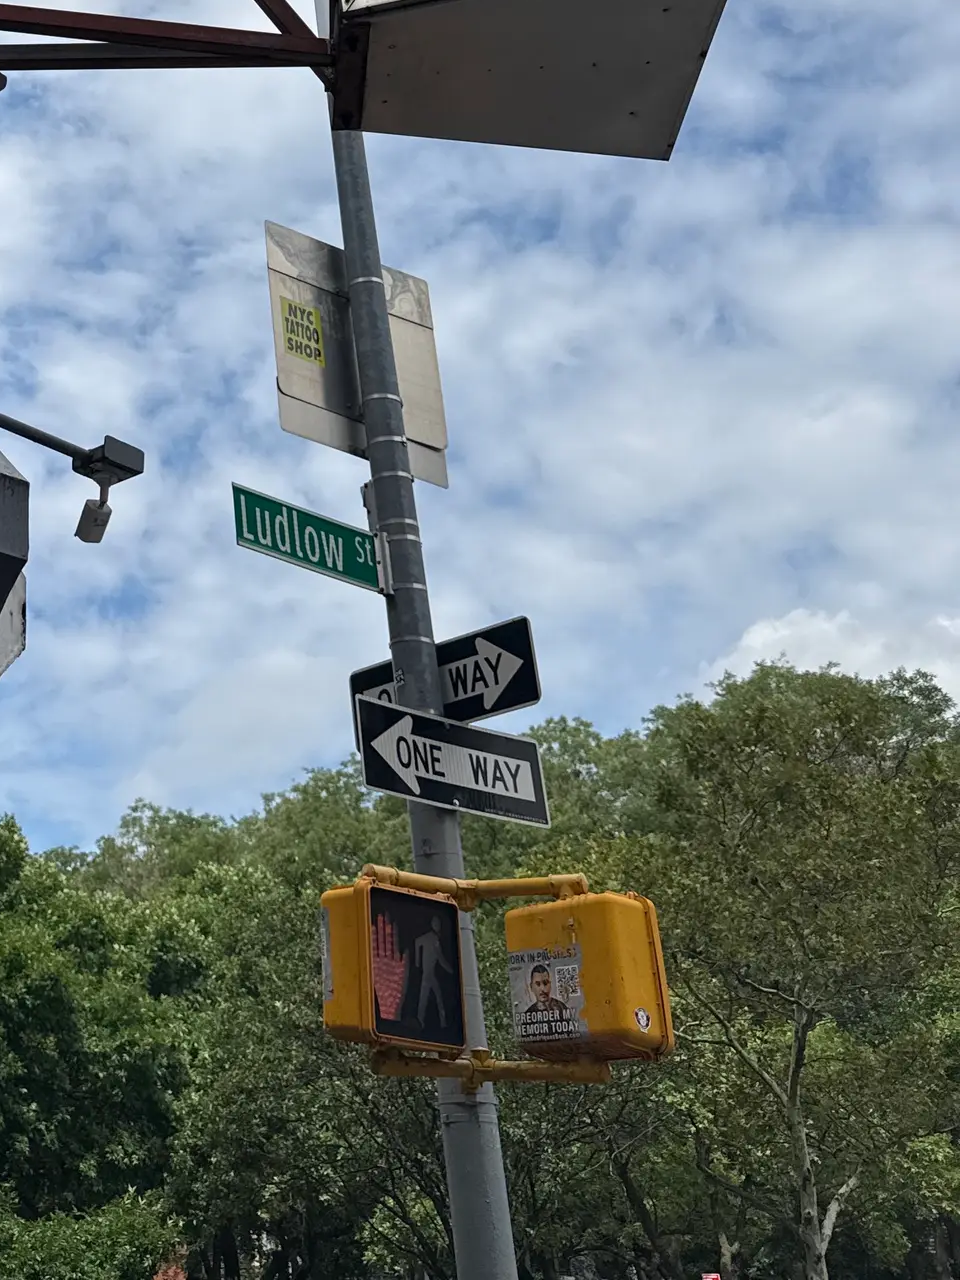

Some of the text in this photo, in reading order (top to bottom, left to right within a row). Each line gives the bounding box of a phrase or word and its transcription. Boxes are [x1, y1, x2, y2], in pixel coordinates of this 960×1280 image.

[288, 303, 314, 326] NYC
[285, 316, 320, 345] TATTOO
[287, 336, 322, 361] SHOP
[240, 494, 374, 572] Ludlow St
[448, 652, 504, 699] WAY
[396, 735, 521, 794] ONE WAY
[508, 952, 526, 965] ORK
[515, 1008, 576, 1023] PREORDER MY
[515, 1020, 579, 1036] MEMOIR TODAY
